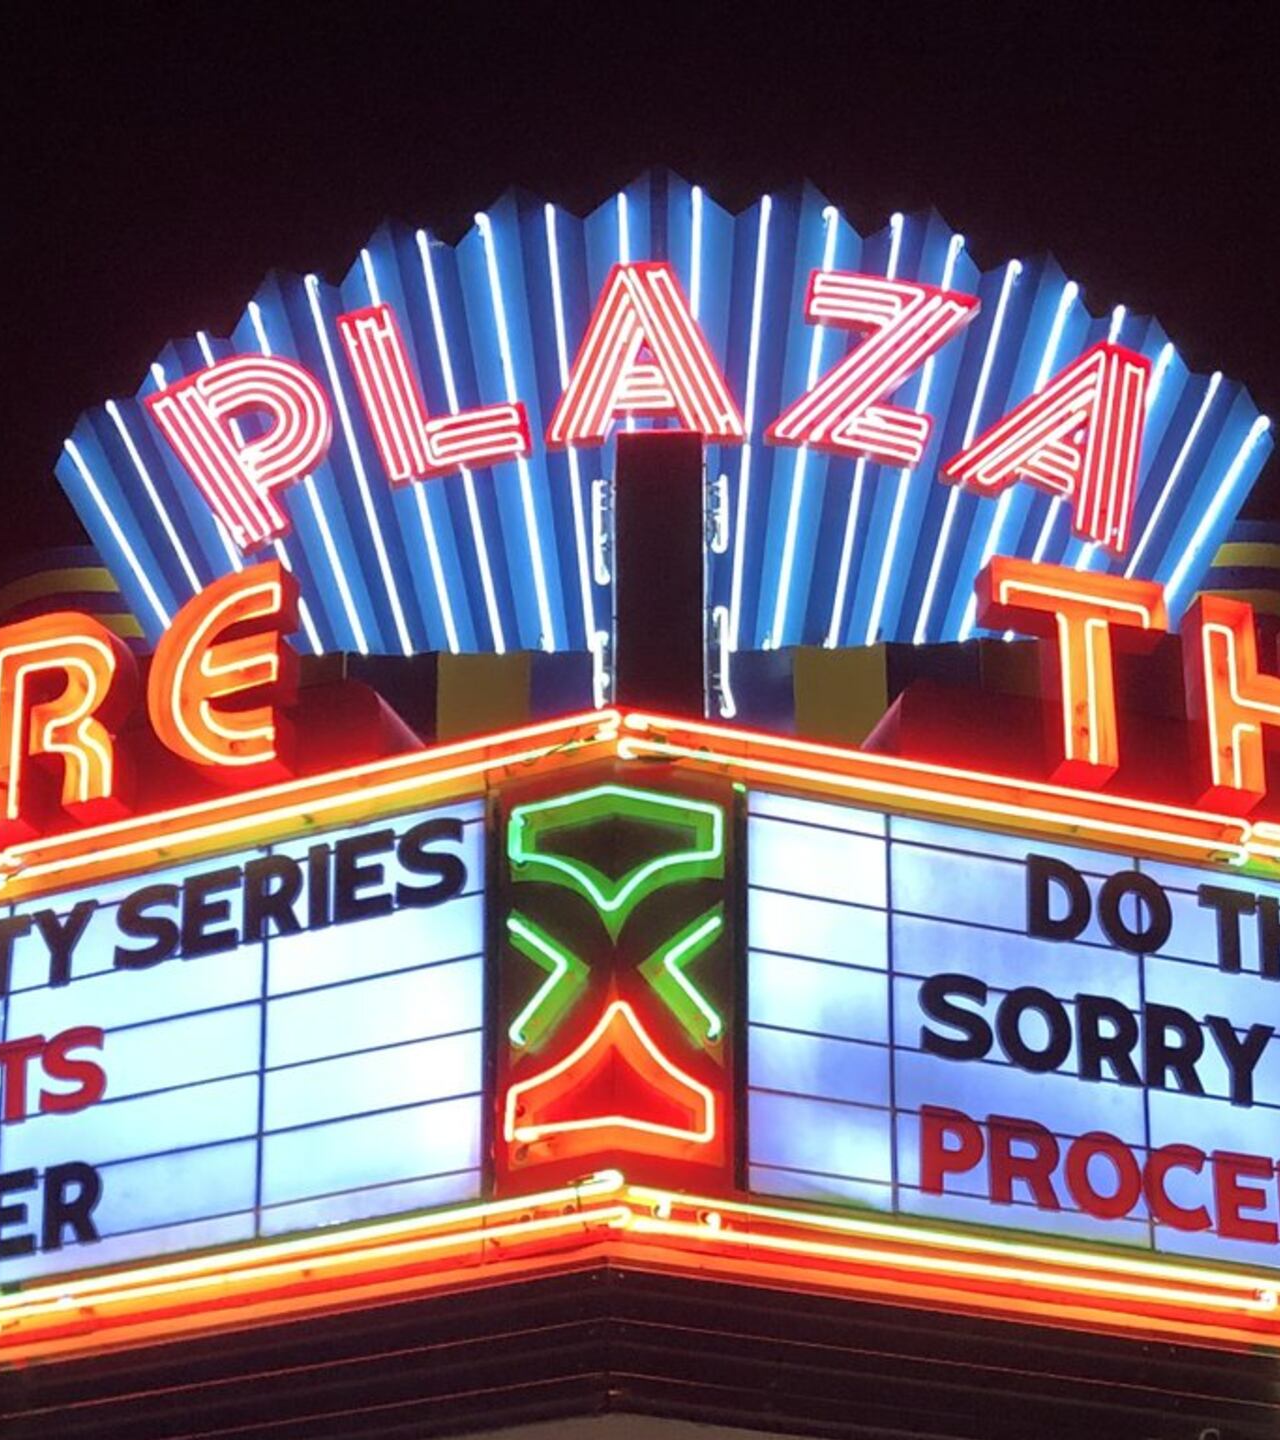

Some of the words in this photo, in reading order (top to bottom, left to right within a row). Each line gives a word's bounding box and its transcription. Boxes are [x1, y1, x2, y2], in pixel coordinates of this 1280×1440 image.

[148, 265, 1160, 555] PLAZA
[111, 816, 469, 969] SERIES
[1027, 855, 1173, 954] DO
[918, 975, 1274, 1109] SORRY
